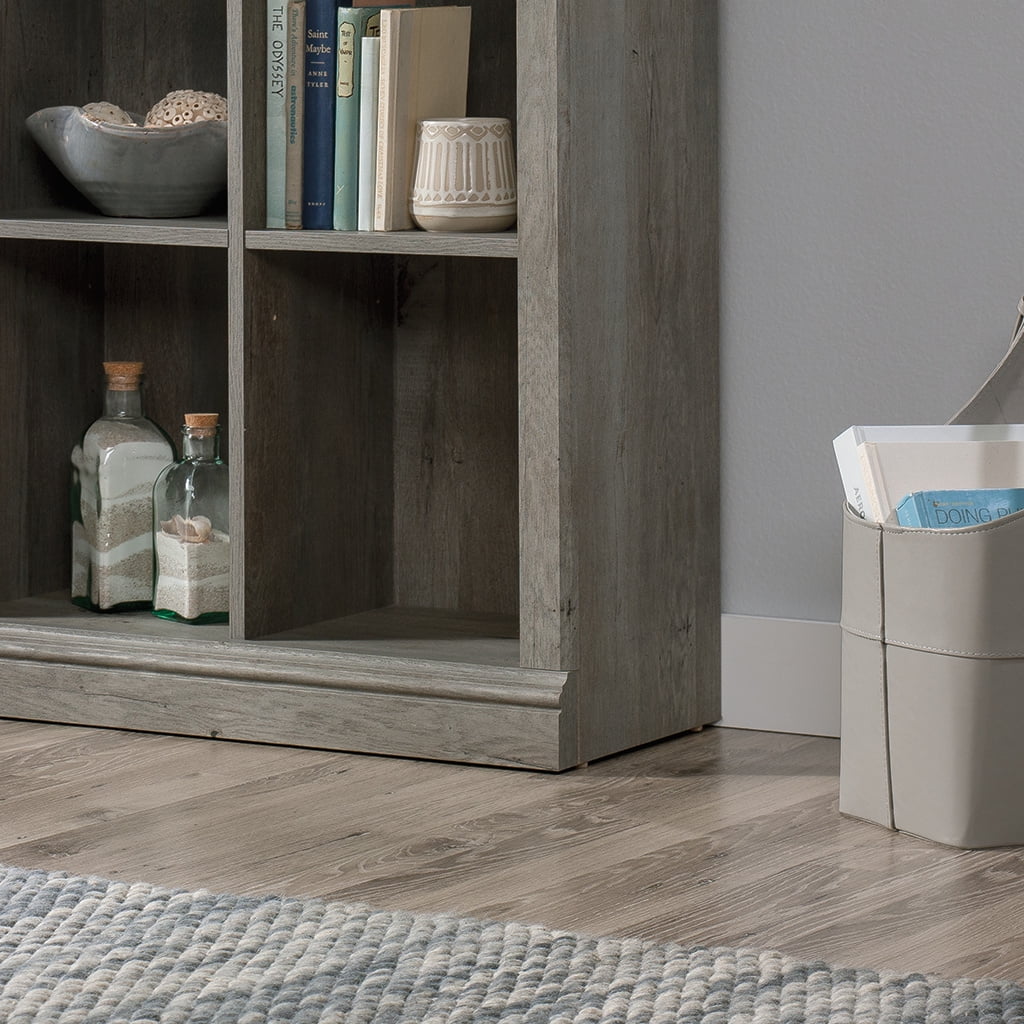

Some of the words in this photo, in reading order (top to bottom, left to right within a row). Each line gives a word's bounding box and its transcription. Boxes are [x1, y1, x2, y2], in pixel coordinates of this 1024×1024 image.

[272, 5, 284, 31] THE
[307, 29, 328, 39] Saint
[290, 34, 298, 69] Adventure
[306, 44, 331, 56] Maybe
[270, 40, 285, 98] ODYSSEY
[289, 85, 297, 145] astronautics
[935, 507, 992, 524] DOING
